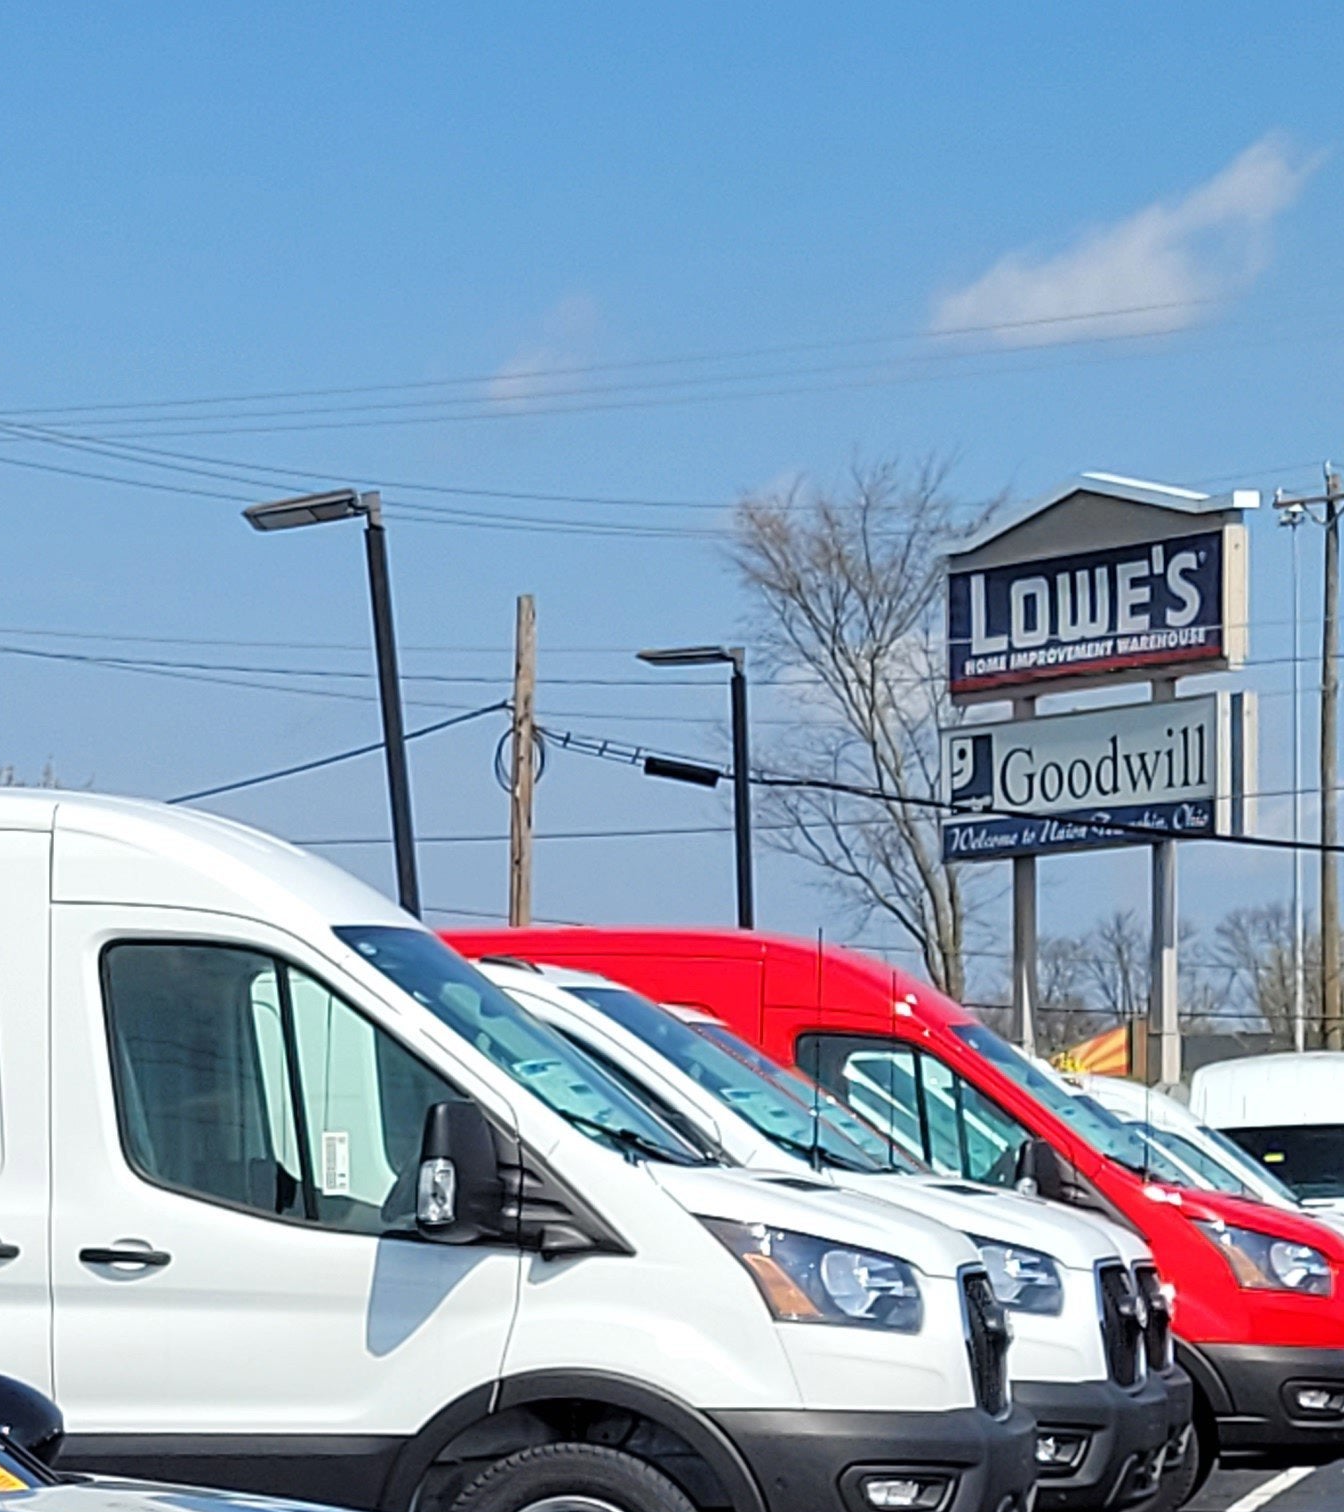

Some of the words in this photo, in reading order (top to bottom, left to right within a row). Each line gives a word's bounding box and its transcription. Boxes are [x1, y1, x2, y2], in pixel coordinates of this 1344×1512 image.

[970, 544, 1202, 655] LOWE'S
[965, 654, 1007, 676] HOME
[1010, 640, 1114, 671] IMPROVEMENT
[1117, 626, 1206, 655] WAREHOUSE
[999, 723, 1208, 807] Goodwill
[951, 825, 1019, 852] Welcome
[1021, 827, 1036, 845] to
